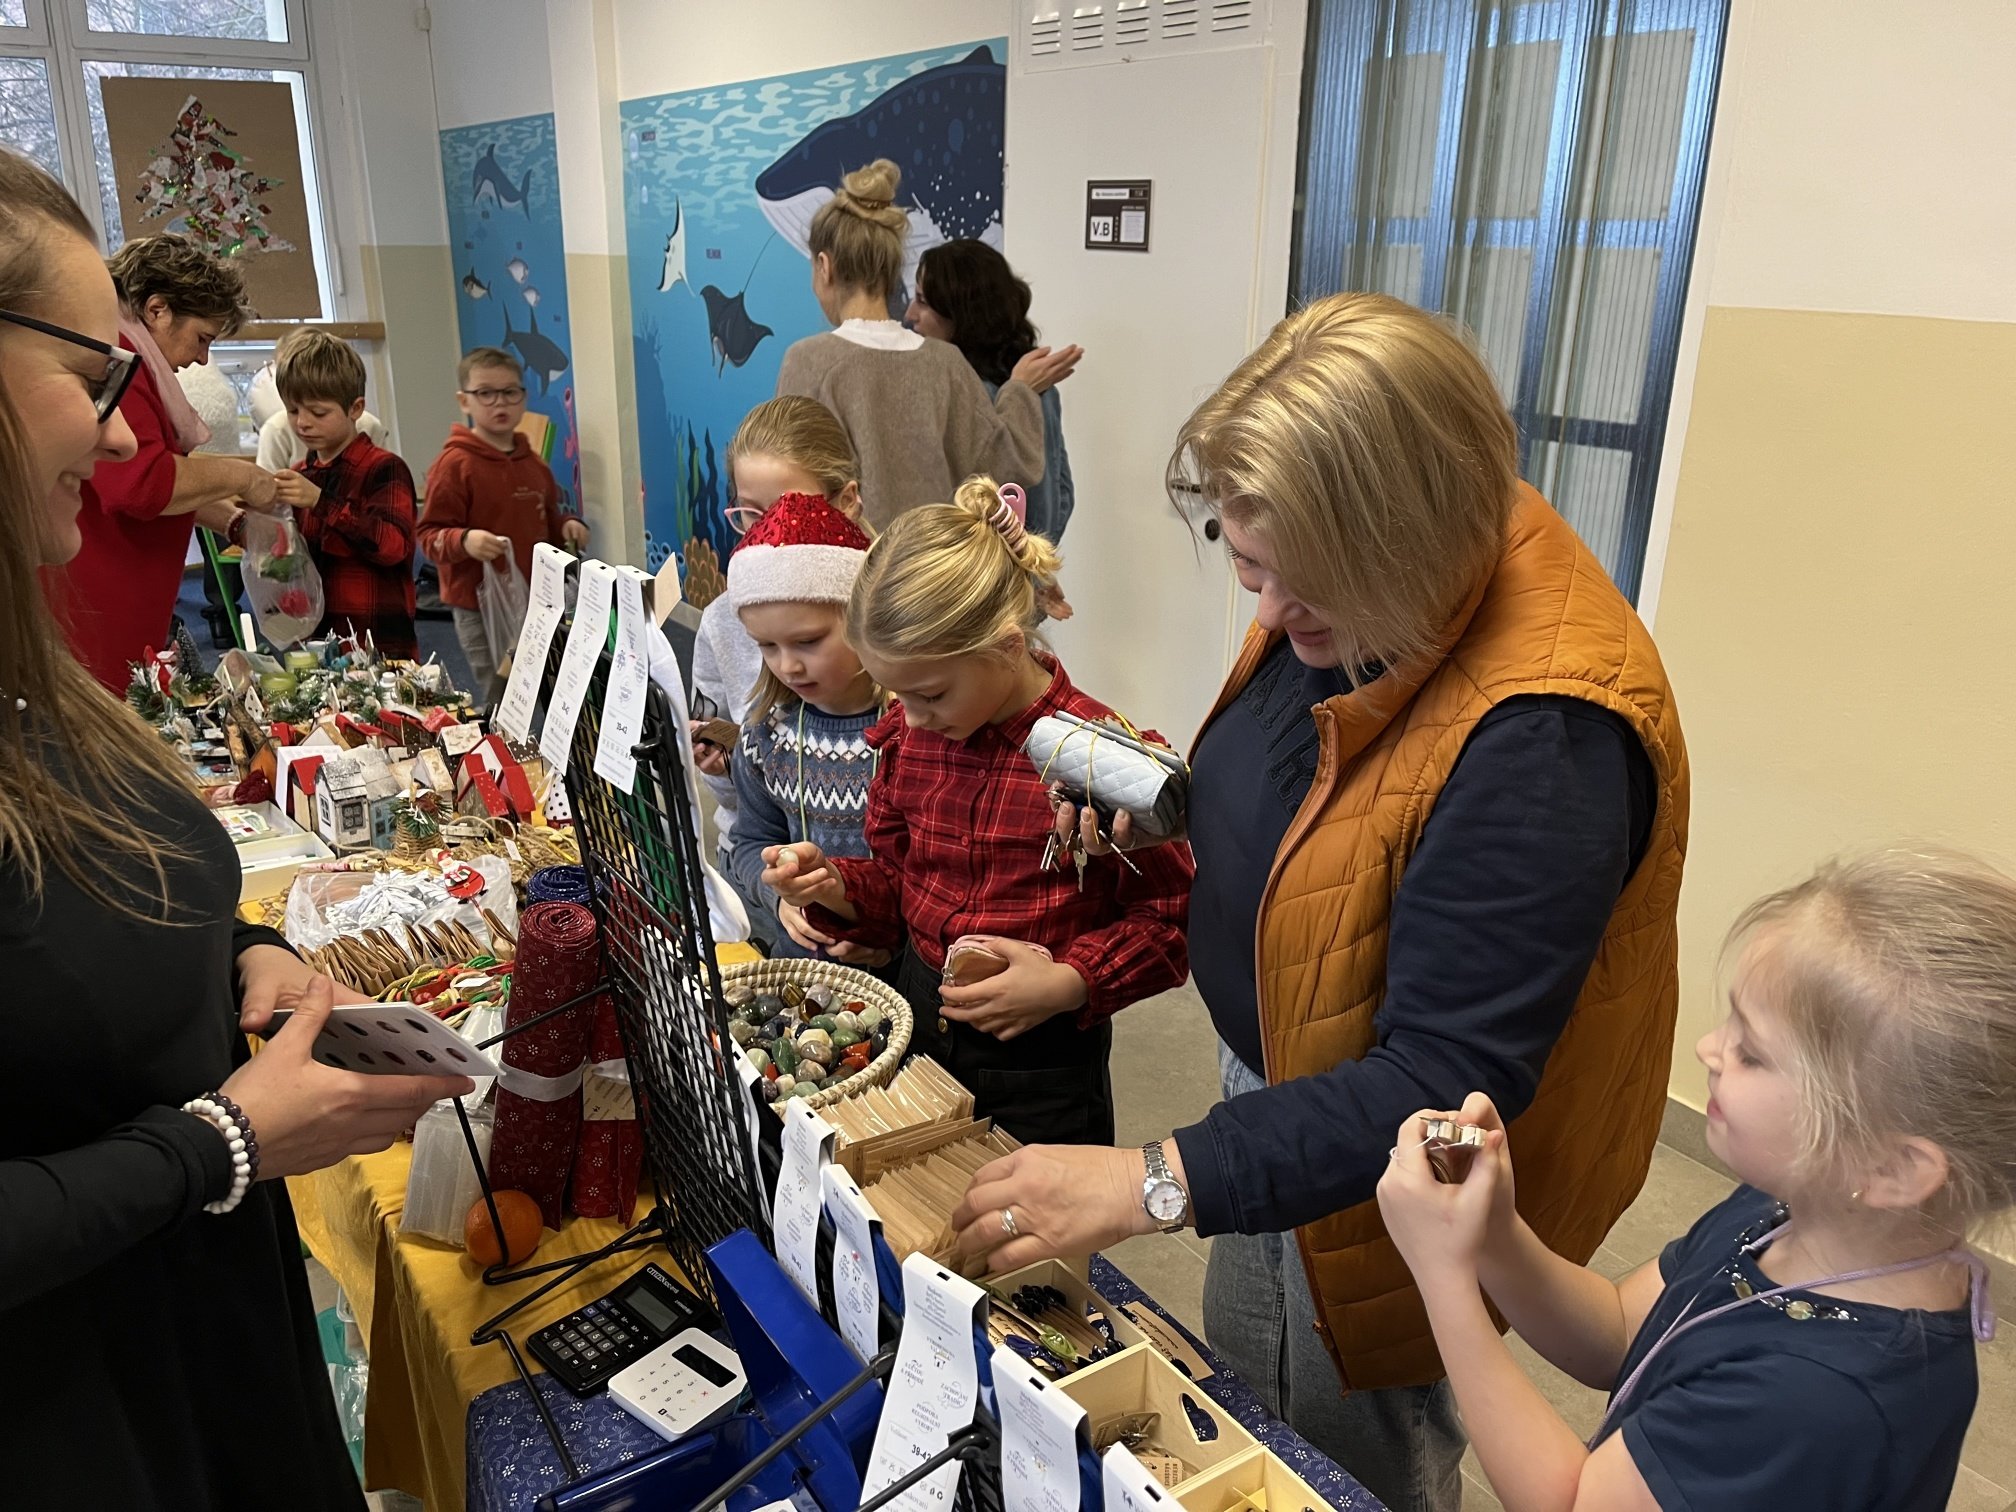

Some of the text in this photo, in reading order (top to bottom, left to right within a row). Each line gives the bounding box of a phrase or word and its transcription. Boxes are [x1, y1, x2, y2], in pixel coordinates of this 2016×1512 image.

[1092, 221, 1110, 236] V.B
[646, 1266, 666, 1284] CITIZEN
[911, 1444, 932, 1461] 39-42
